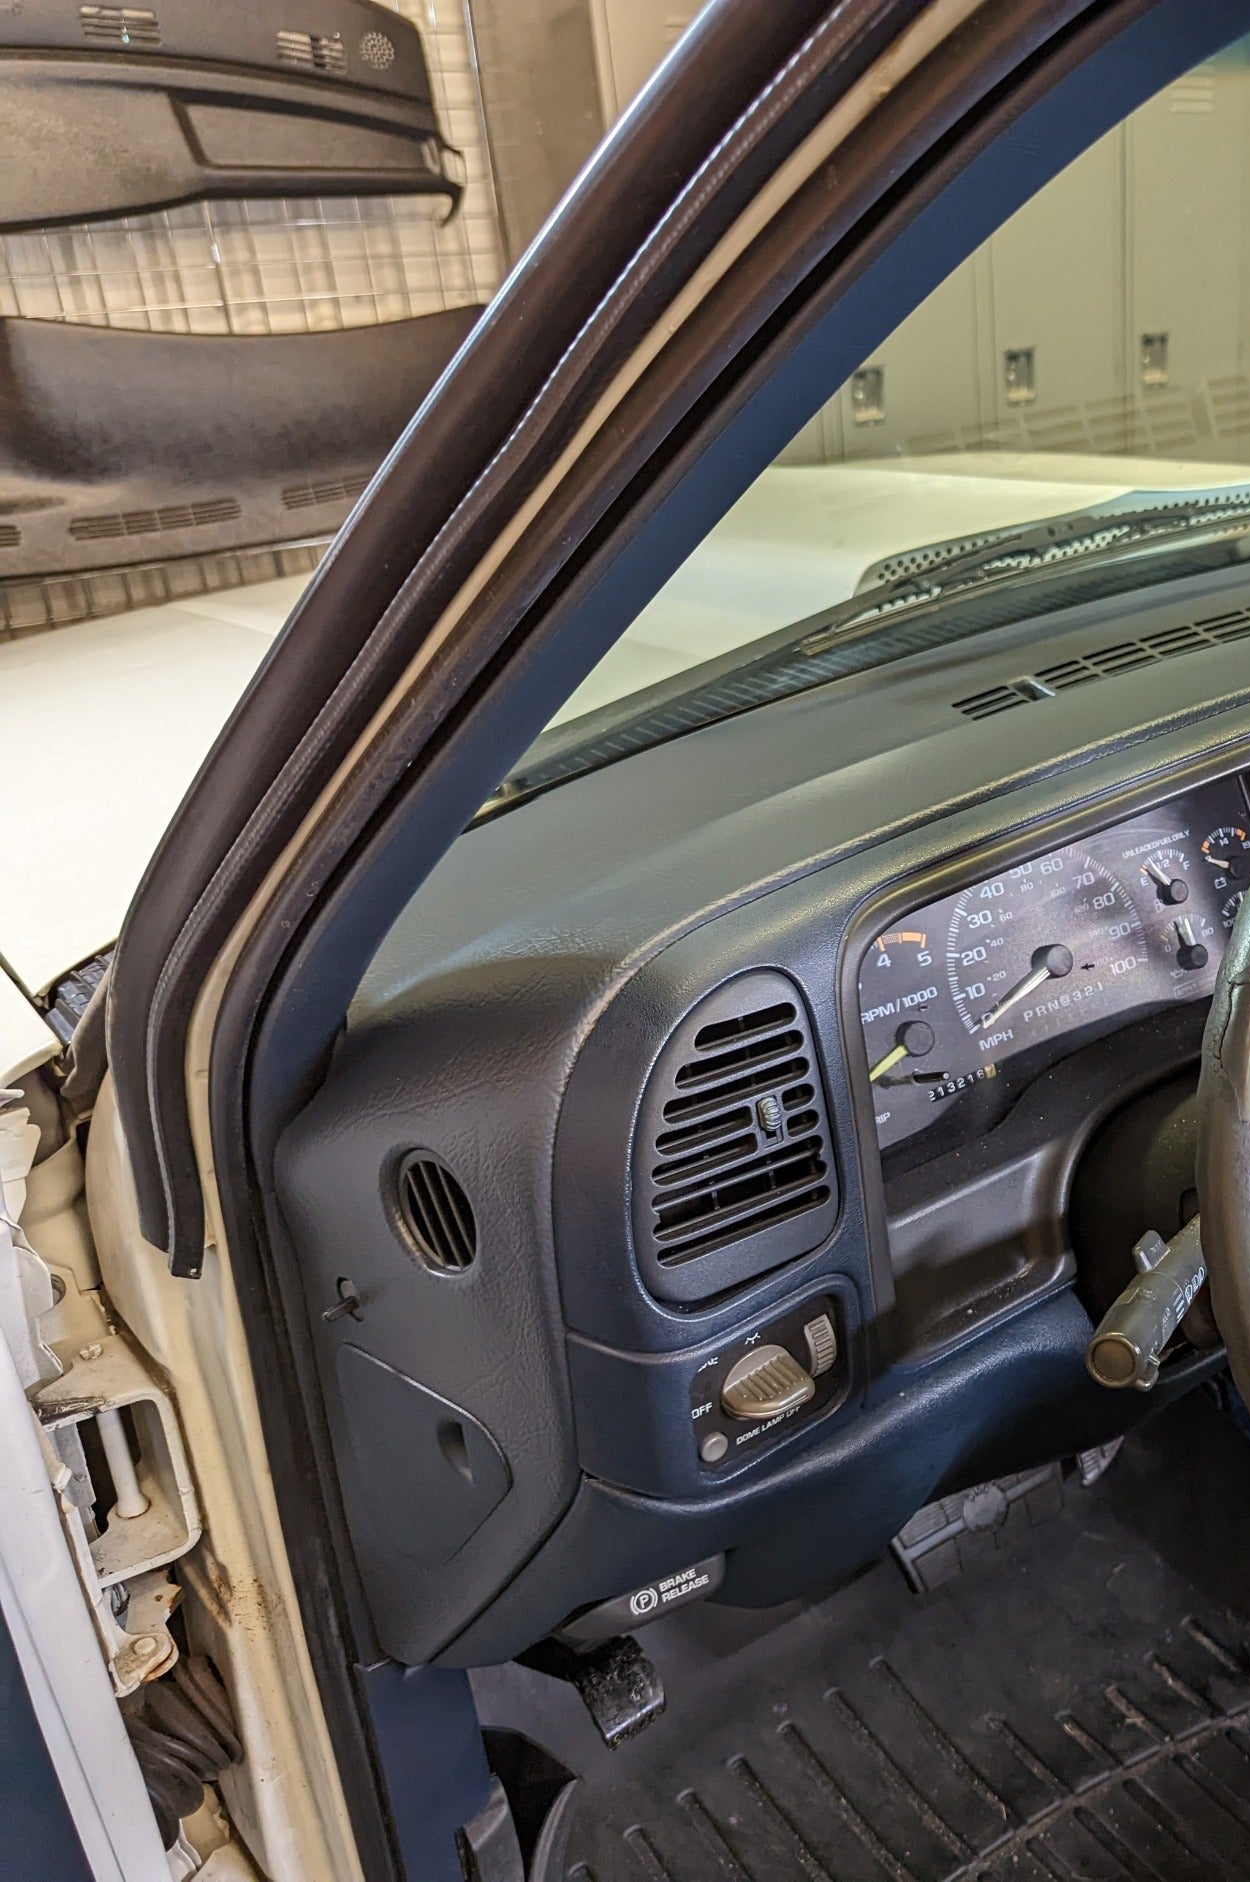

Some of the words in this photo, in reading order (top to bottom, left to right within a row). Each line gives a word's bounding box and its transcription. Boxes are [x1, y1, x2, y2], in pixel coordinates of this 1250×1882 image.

[1121, 842, 1157, 859] UNLEADED
[1157, 836, 1173, 847] FUEL
[1171, 829, 1190, 843] ONLY
[1009, 862, 1033, 879] 50
[1040, 857, 1064, 875] 60
[1182, 860, 1191, 871] F
[1020, 882, 1034, 892] 80
[1072, 871, 1095, 889] 70
[1140, 876, 1149, 887] E
[980, 881, 1005, 899] 40
[1092, 892, 1116, 910] 80
[966, 910, 993, 929] 30
[999, 911, 1013, 922] 60
[1108, 921, 1131, 940] 90
[989, 937, 1005, 947] 40
[876, 953, 892, 968] 4
[916, 950, 932, 967] 5
[961, 946, 988, 967] 20
[1109, 955, 1137, 976] 100
[992, 970, 1007, 982] 20
[965, 982, 986, 1000] 10
[860, 986, 938, 1025] RPM/1000
[978, 1028, 1014, 1051] MPH
[875, 1111, 891, 1124] RIP
[691, 1401, 713, 1420] OFF
[736, 1426, 761, 1446] DOME
[761, 1414, 785, 1431] LAMP
[659, 1568, 697, 1592] BRAKE
[661, 1574, 710, 1603] RELEASE
